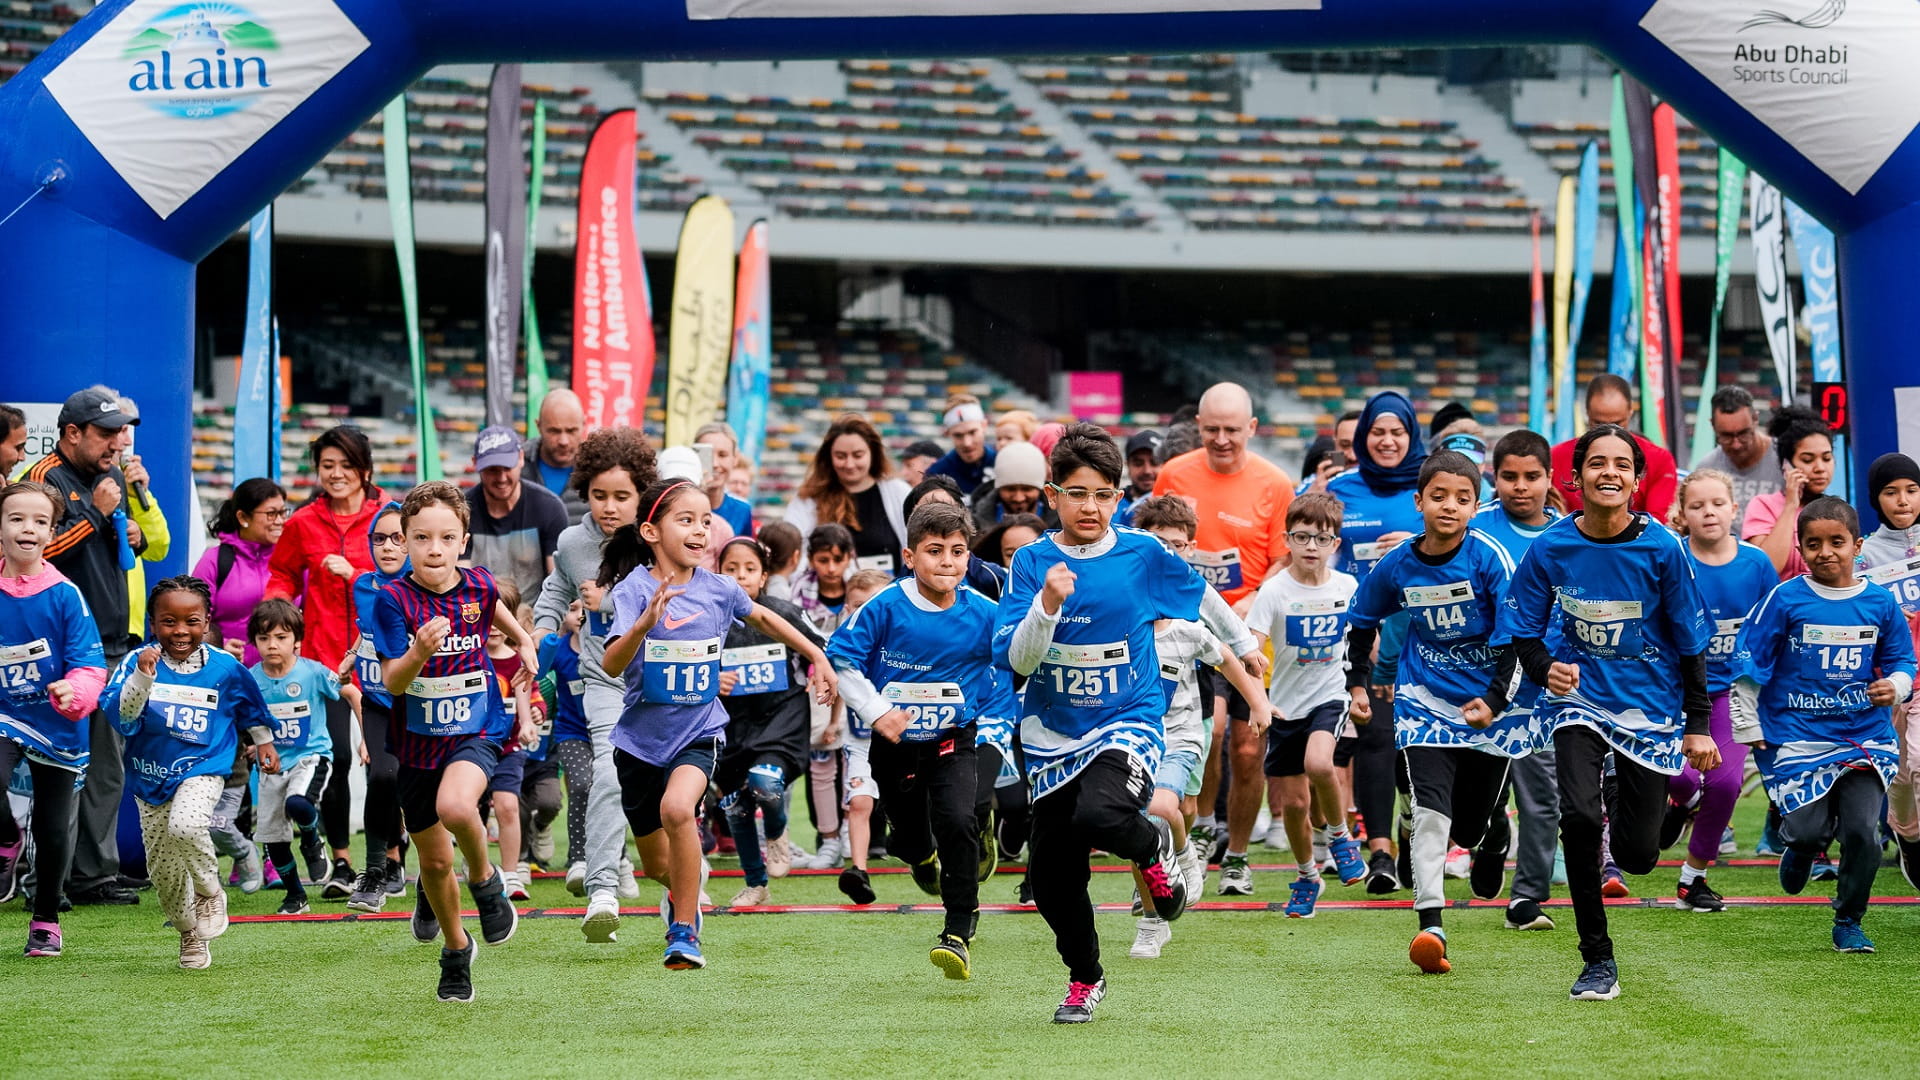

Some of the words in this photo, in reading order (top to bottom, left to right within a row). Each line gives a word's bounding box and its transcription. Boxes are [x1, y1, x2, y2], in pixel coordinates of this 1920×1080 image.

[1734, 43, 1776, 62] Abu
[1785, 44, 1847, 64] Dhabi
[129, 50, 176, 91] al
[184, 48, 272, 90] ain
[1732, 65, 1785, 83] Sports
[1789, 67, 1848, 85] Council
[602, 187, 631, 351] Ambulance
[1821, 386, 1847, 430] 0
[23, 436, 55, 456] CB
[1889, 578, 1920, 605] 16
[1300, 615, 1338, 637] 122
[1422, 605, 1467, 631] 144
[1575, 620, 1625, 647] 867
[1709, 636, 1736, 655] 38
[1818, 647, 1863, 670] 145
[0, 662, 41, 689] 124
[360, 660, 382, 684] 10
[663, 664, 710, 692] 113
[736, 663, 775, 686] 133
[1051, 667, 1118, 696] 1251
[163, 705, 209, 733] 135
[421, 697, 471, 724] 108
[276, 719, 301, 739] 05
